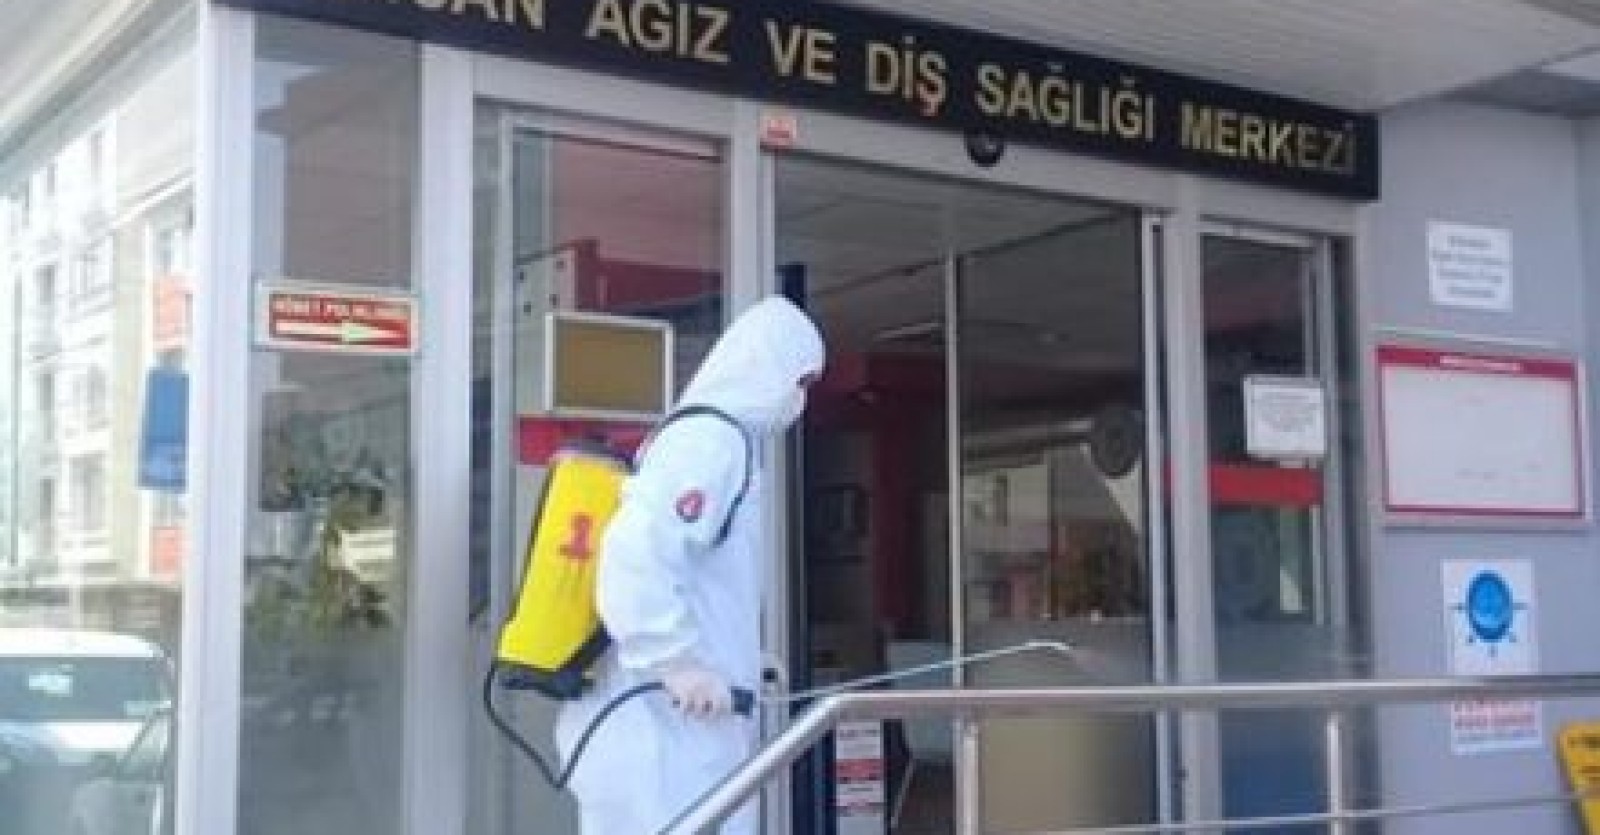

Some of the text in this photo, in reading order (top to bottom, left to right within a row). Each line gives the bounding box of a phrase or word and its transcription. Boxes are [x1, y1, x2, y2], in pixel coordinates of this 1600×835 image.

[764, 20, 837, 84] VE
[865, 35, 948, 117] DİŞ
[974, 61, 1155, 142] SAĞLIĞI
[1180, 102, 1358, 175] MERKEZİ
